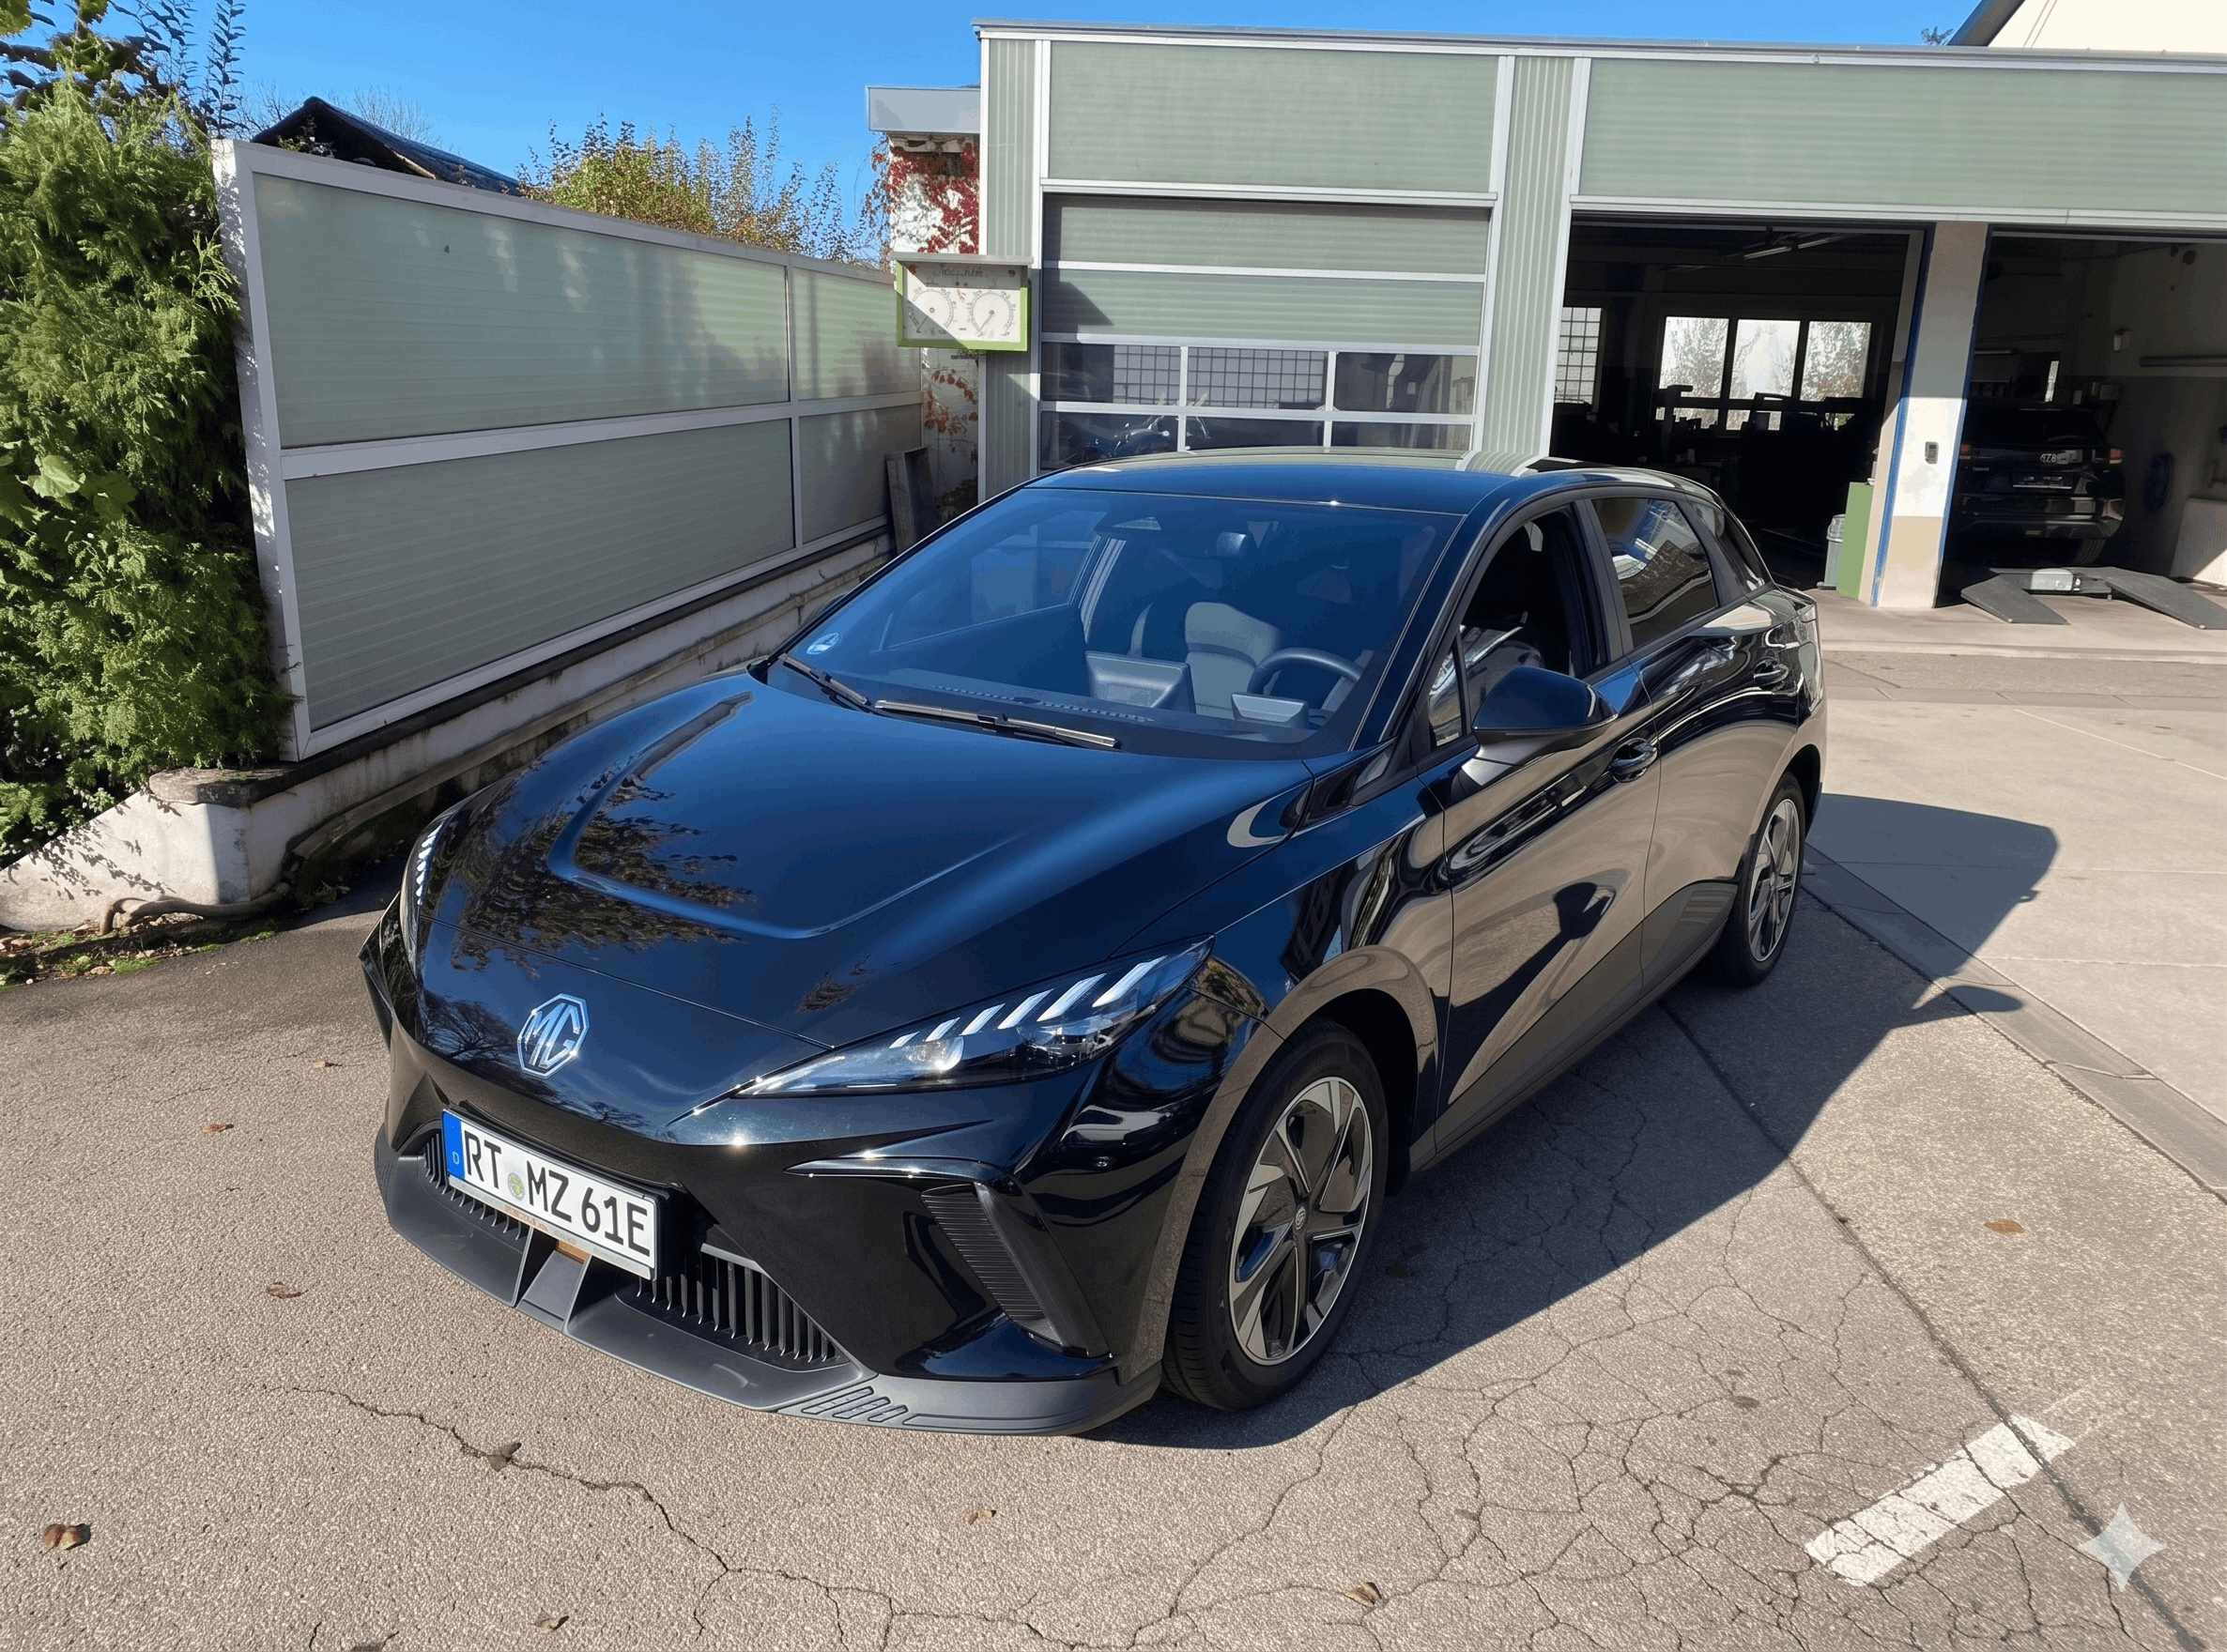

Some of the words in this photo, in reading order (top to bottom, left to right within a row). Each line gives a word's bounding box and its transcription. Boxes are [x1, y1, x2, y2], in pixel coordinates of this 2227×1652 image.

[523, 1001, 582, 1070] MG
[464, 1129, 502, 1190] RT
[526, 1159, 573, 1224] MZ
[580, 1186, 651, 1258] 61E
